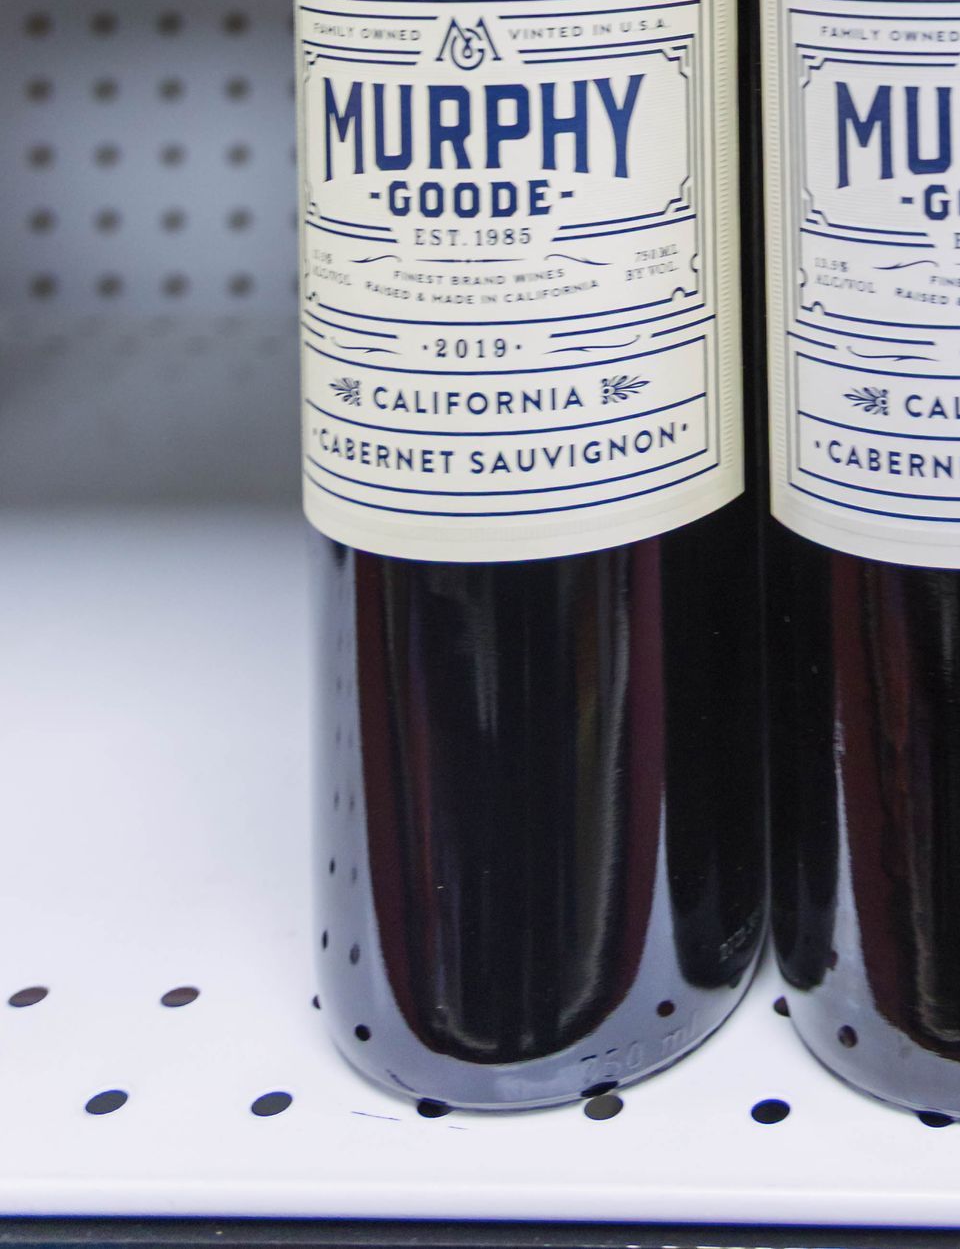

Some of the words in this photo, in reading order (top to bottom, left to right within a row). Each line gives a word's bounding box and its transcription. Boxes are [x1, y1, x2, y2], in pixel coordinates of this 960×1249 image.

[360, 28, 421, 41] OWNED
[508, 26, 583, 39] VINTED
[592, 23, 611, 36] IN
[820, 25, 880, 41] FAMILY
[890, 29, 960, 43] OWNED
[323, 73, 646, 183] MURPHY
[393, 270, 443, 285] FINEST
[452, 275, 506, 286] BRAND
[513, 268, 565, 284] WINES
[366, 280, 412, 300] RAISED
[416, 291, 425, 302] &
[432, 293, 474, 304] MADE
[481, 294, 496, 304] IN
[506, 279, 599, 304] CALIFORNIA
[372, 386, 584, 416] CALIFORNIA
